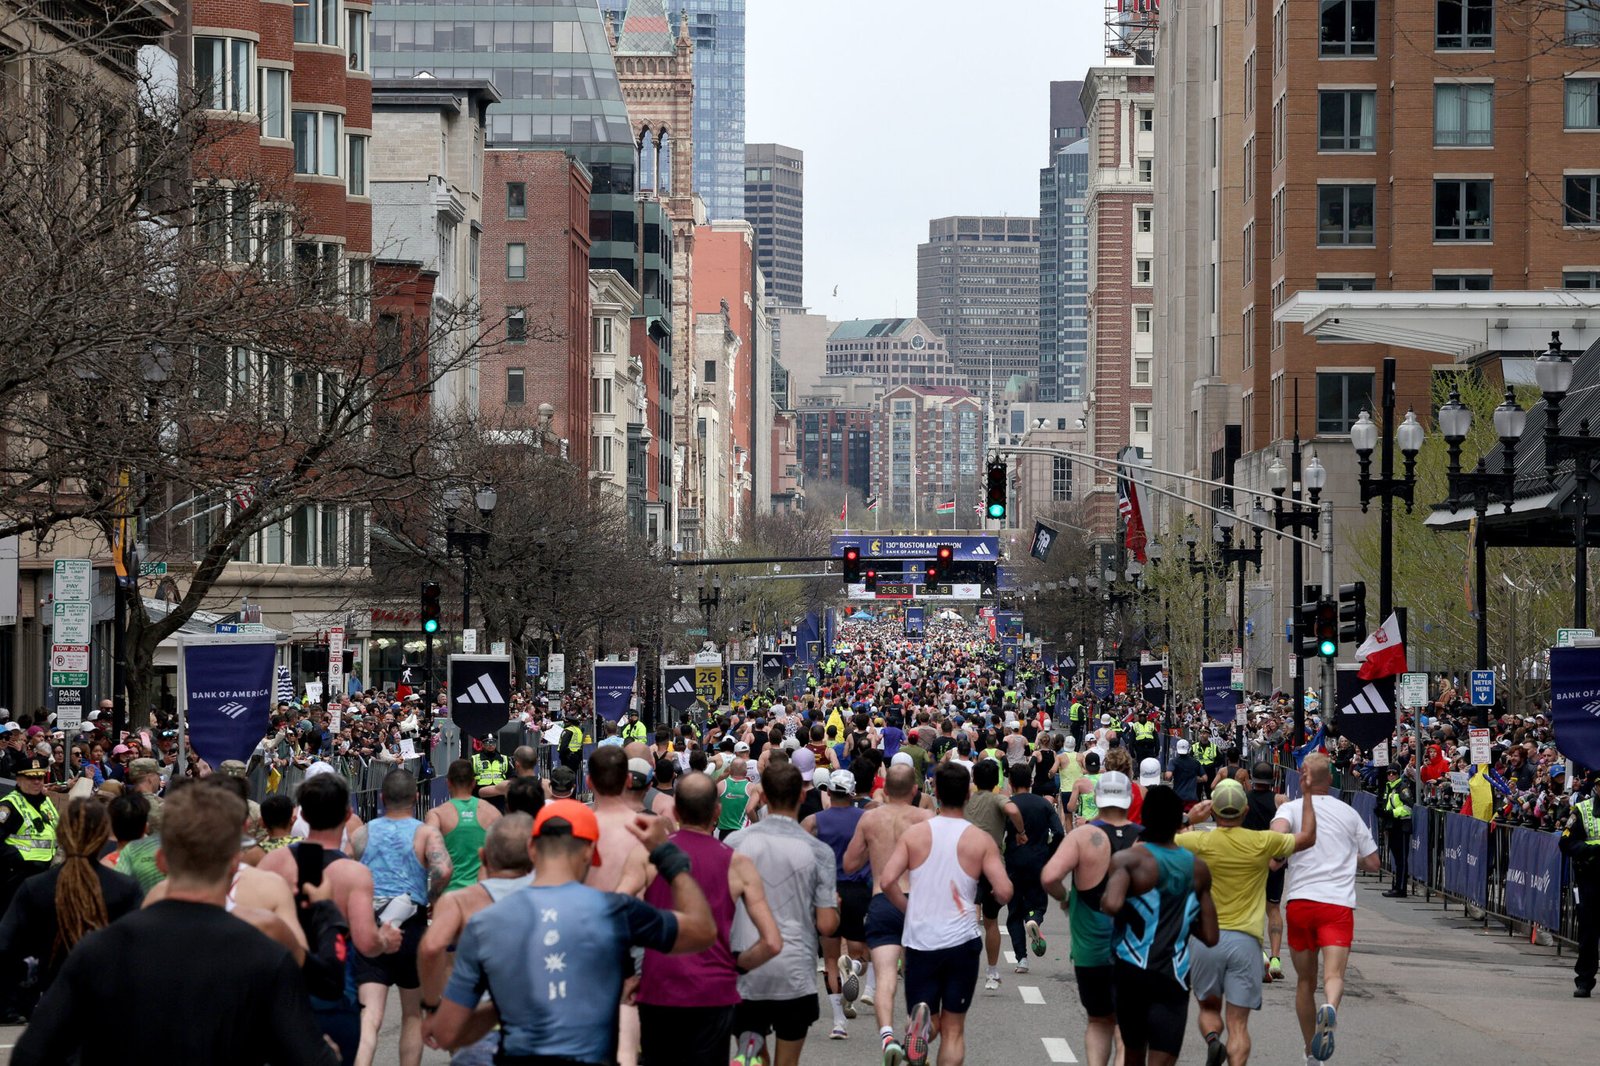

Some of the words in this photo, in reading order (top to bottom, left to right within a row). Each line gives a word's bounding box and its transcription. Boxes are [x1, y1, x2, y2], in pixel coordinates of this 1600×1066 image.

[57, 562, 64, 570] 2
[1560, 631, 1568, 639] 2
[699, 672, 717, 683] 26
[232, 689, 268, 698] AMERICA
